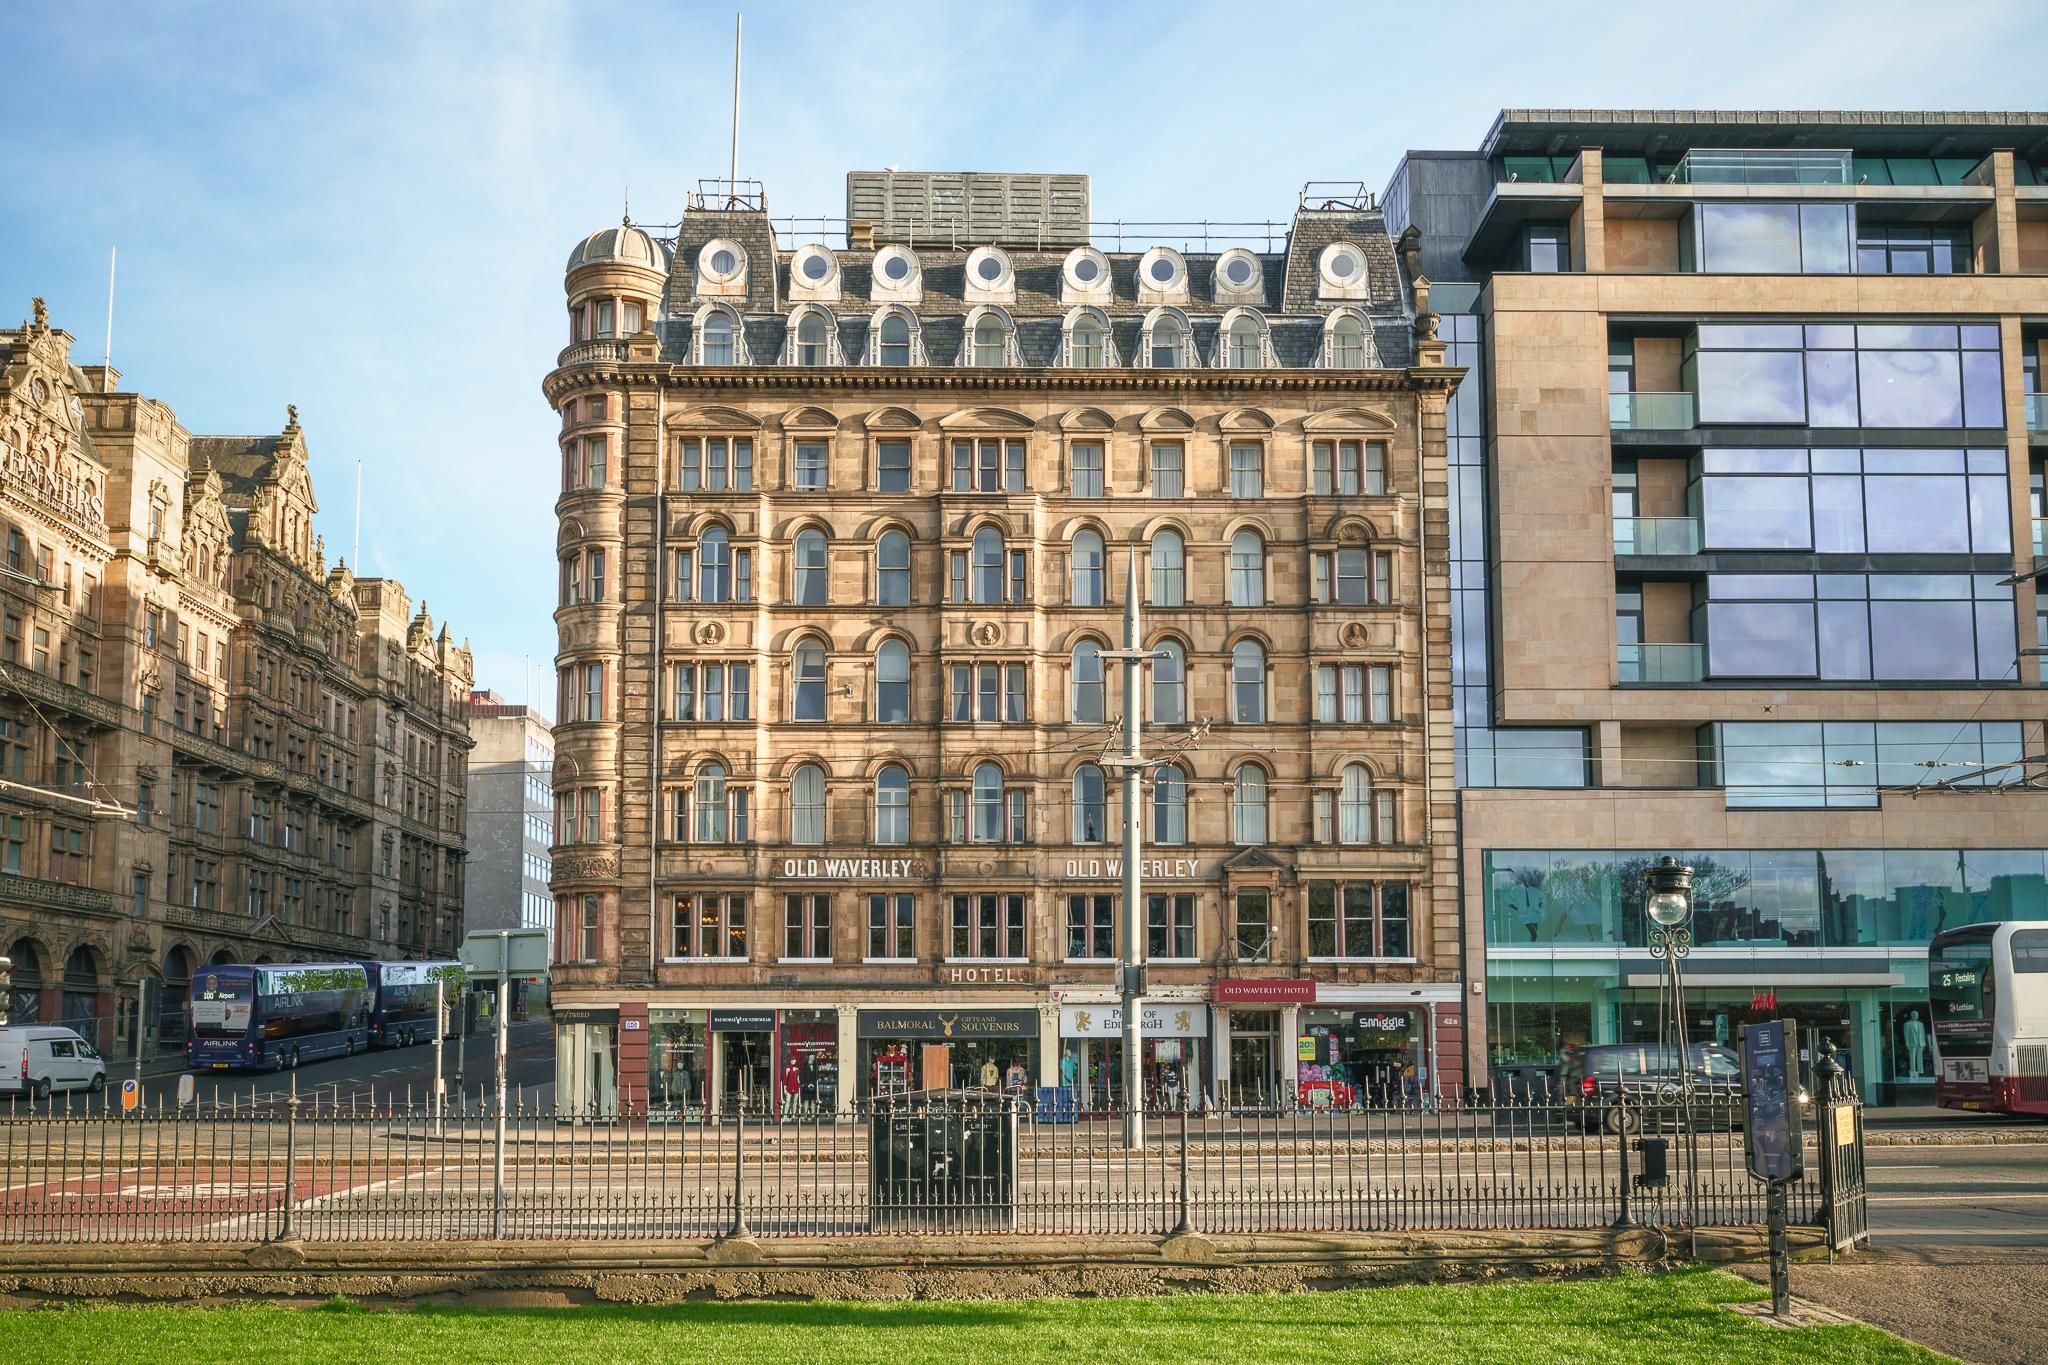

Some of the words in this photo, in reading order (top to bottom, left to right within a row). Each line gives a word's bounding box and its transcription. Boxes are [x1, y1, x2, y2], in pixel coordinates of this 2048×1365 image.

[784, 859, 818, 877] OLD
[824, 859, 912, 877] WAVERLEY
[1066, 860, 1100, 877] OLD
[1105, 859, 1199, 877] WERLEY
[951, 968, 1023, 982] HOTEL.
[1943, 974, 1951, 987] 25
[1955, 973, 1976, 984] Restalrig
[203, 992, 214, 1000] 100
[218, 992, 235, 1000] Airport
[392, 986, 418, 996] AIRLINK
[274, 995, 304, 1009] AIRLINK
[1956, 1003, 1975, 1012] Lothian
[1143, 1010, 1157, 1018] OF
[877, 1020, 935, 1030] BALMORAL
[961, 1022, 1020, 1031] SOUVENIRS
[1104, 1019, 1163, 1029] EDIRGH
